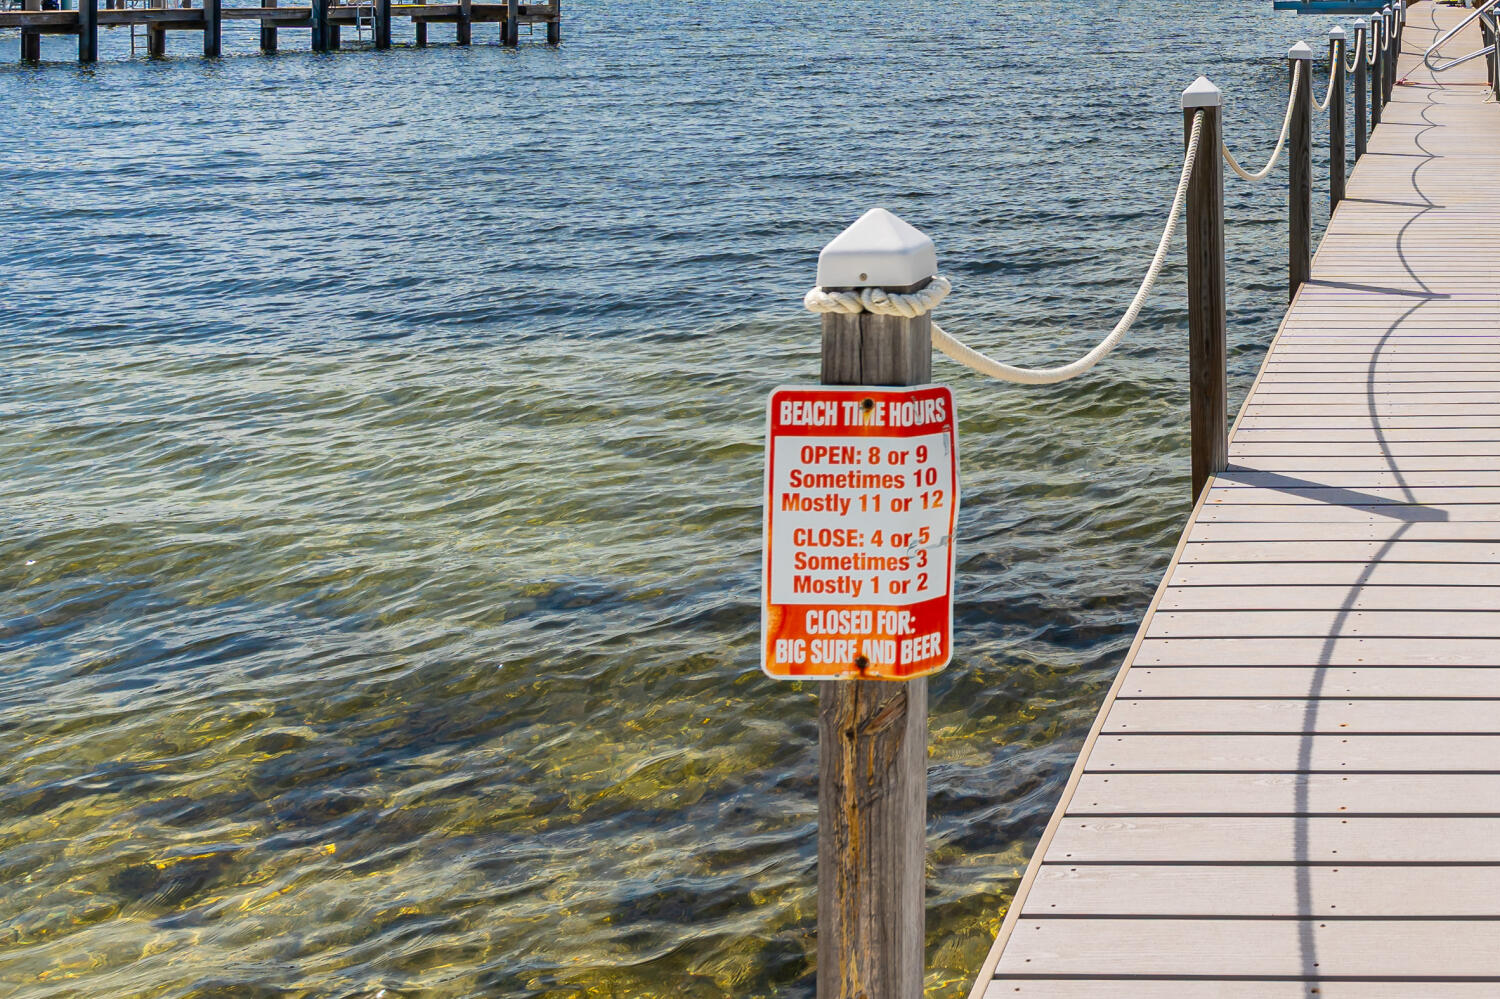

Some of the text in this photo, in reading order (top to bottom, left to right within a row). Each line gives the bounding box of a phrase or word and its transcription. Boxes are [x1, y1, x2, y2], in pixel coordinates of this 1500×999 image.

[780, 397, 946, 427] BEACH TIME HOURS
[800, 444, 928, 466] OPEN: 8 or 9
[789, 467, 938, 489] Sometimes 10
[781, 490, 944, 516] Mostly 11 or 12
[793, 526, 930, 548] CLOSE: 4 or 5
[794, 549, 928, 571] Sometimes 3
[793, 572, 928, 598] Mostly 1 or 2
[805, 609, 917, 636] CLOSED FOR:
[775, 631, 942, 665] BIG SURF AND BEER
